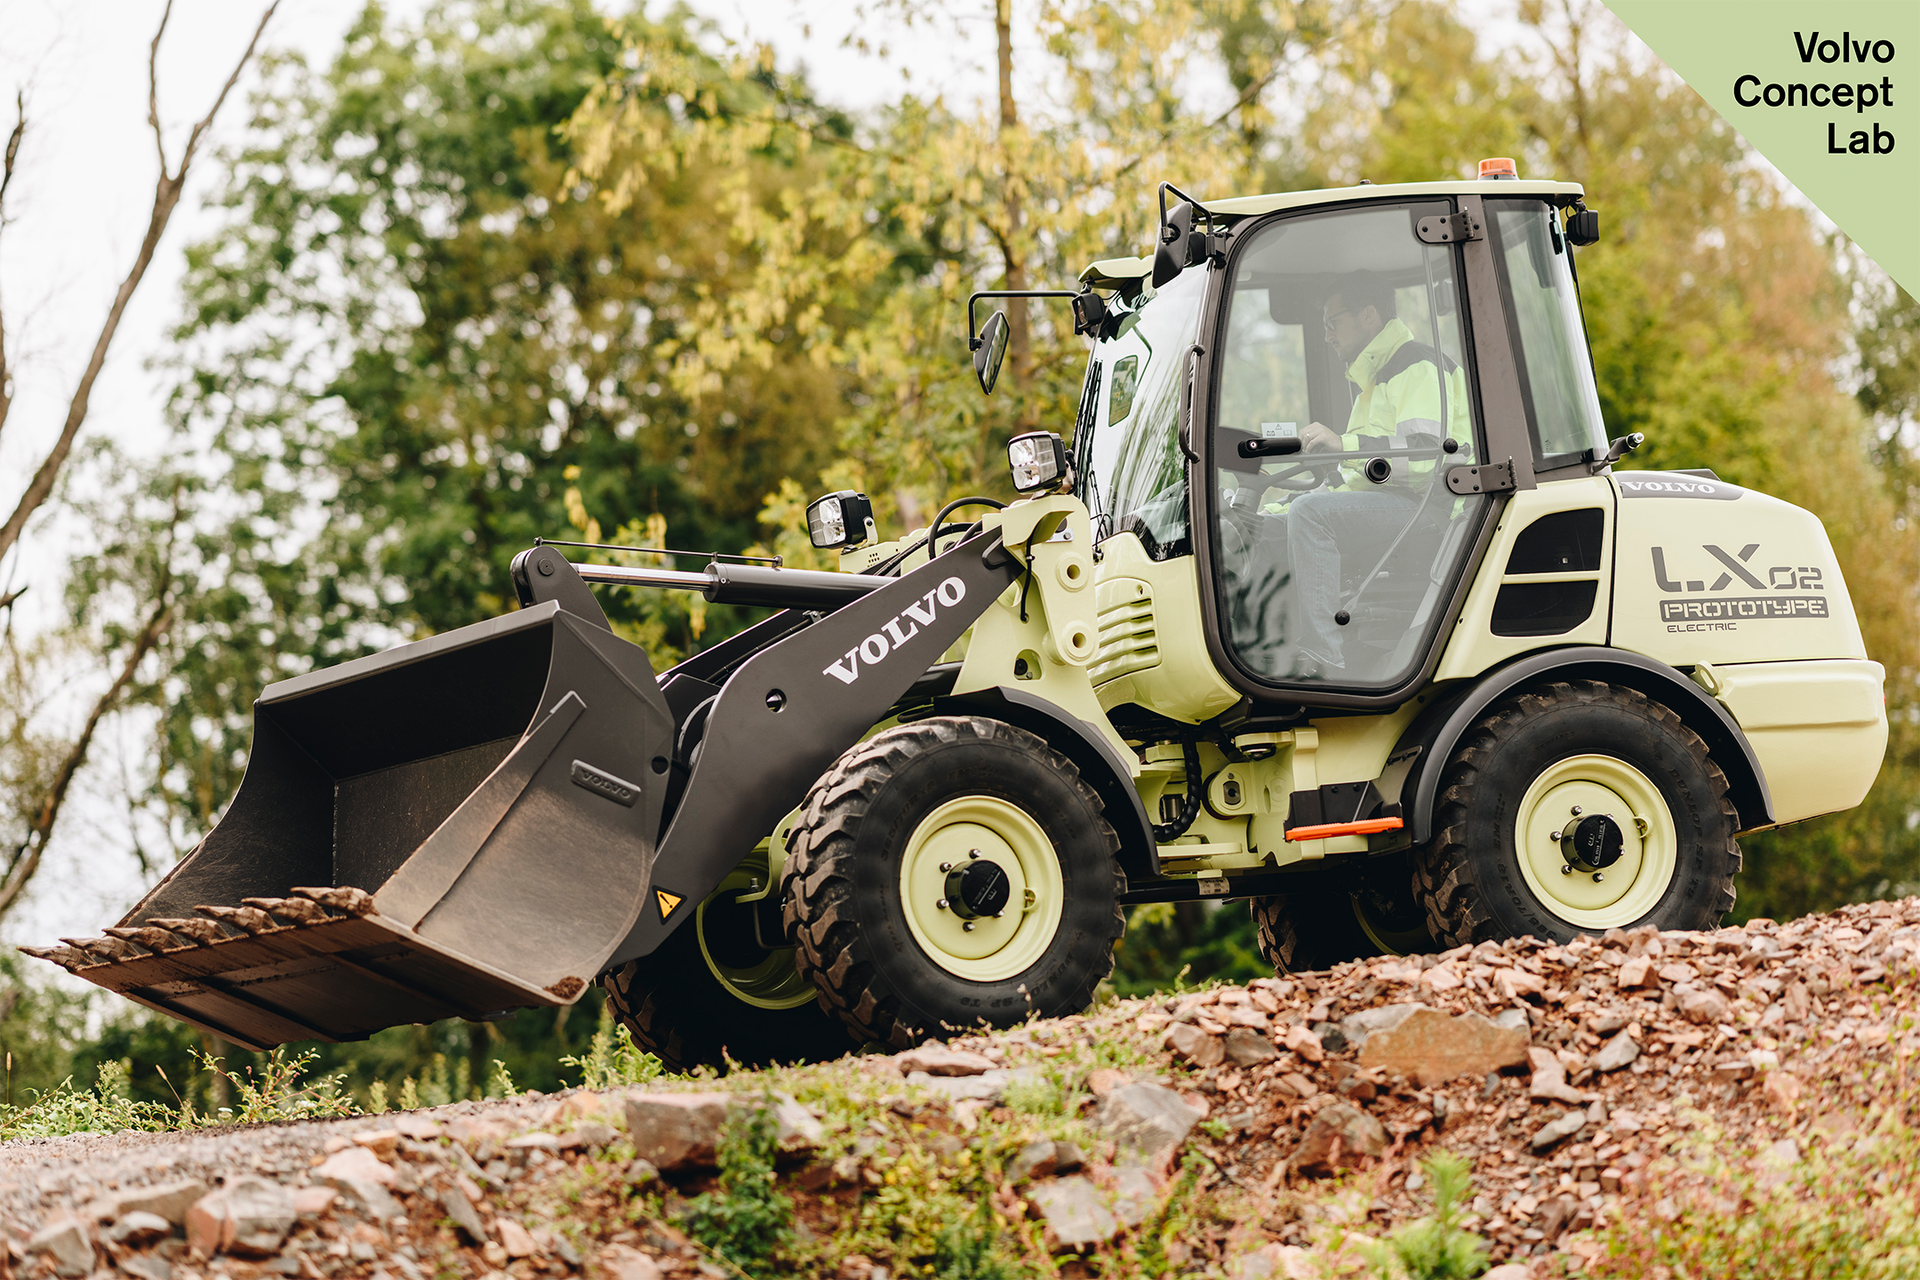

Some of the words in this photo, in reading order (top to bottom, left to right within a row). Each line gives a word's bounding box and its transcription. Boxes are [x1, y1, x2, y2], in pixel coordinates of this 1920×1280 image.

[1621, 481, 1716, 495] VOLVO
[1663, 599, 1827, 620] PROTOTYPE
[822, 576, 968, 686] VOLVO
[1666, 622, 1738, 634] ELECTRIC
[580, 768, 631, 799] VOLVO
[1668, 766, 1703, 838] DUNLOP
